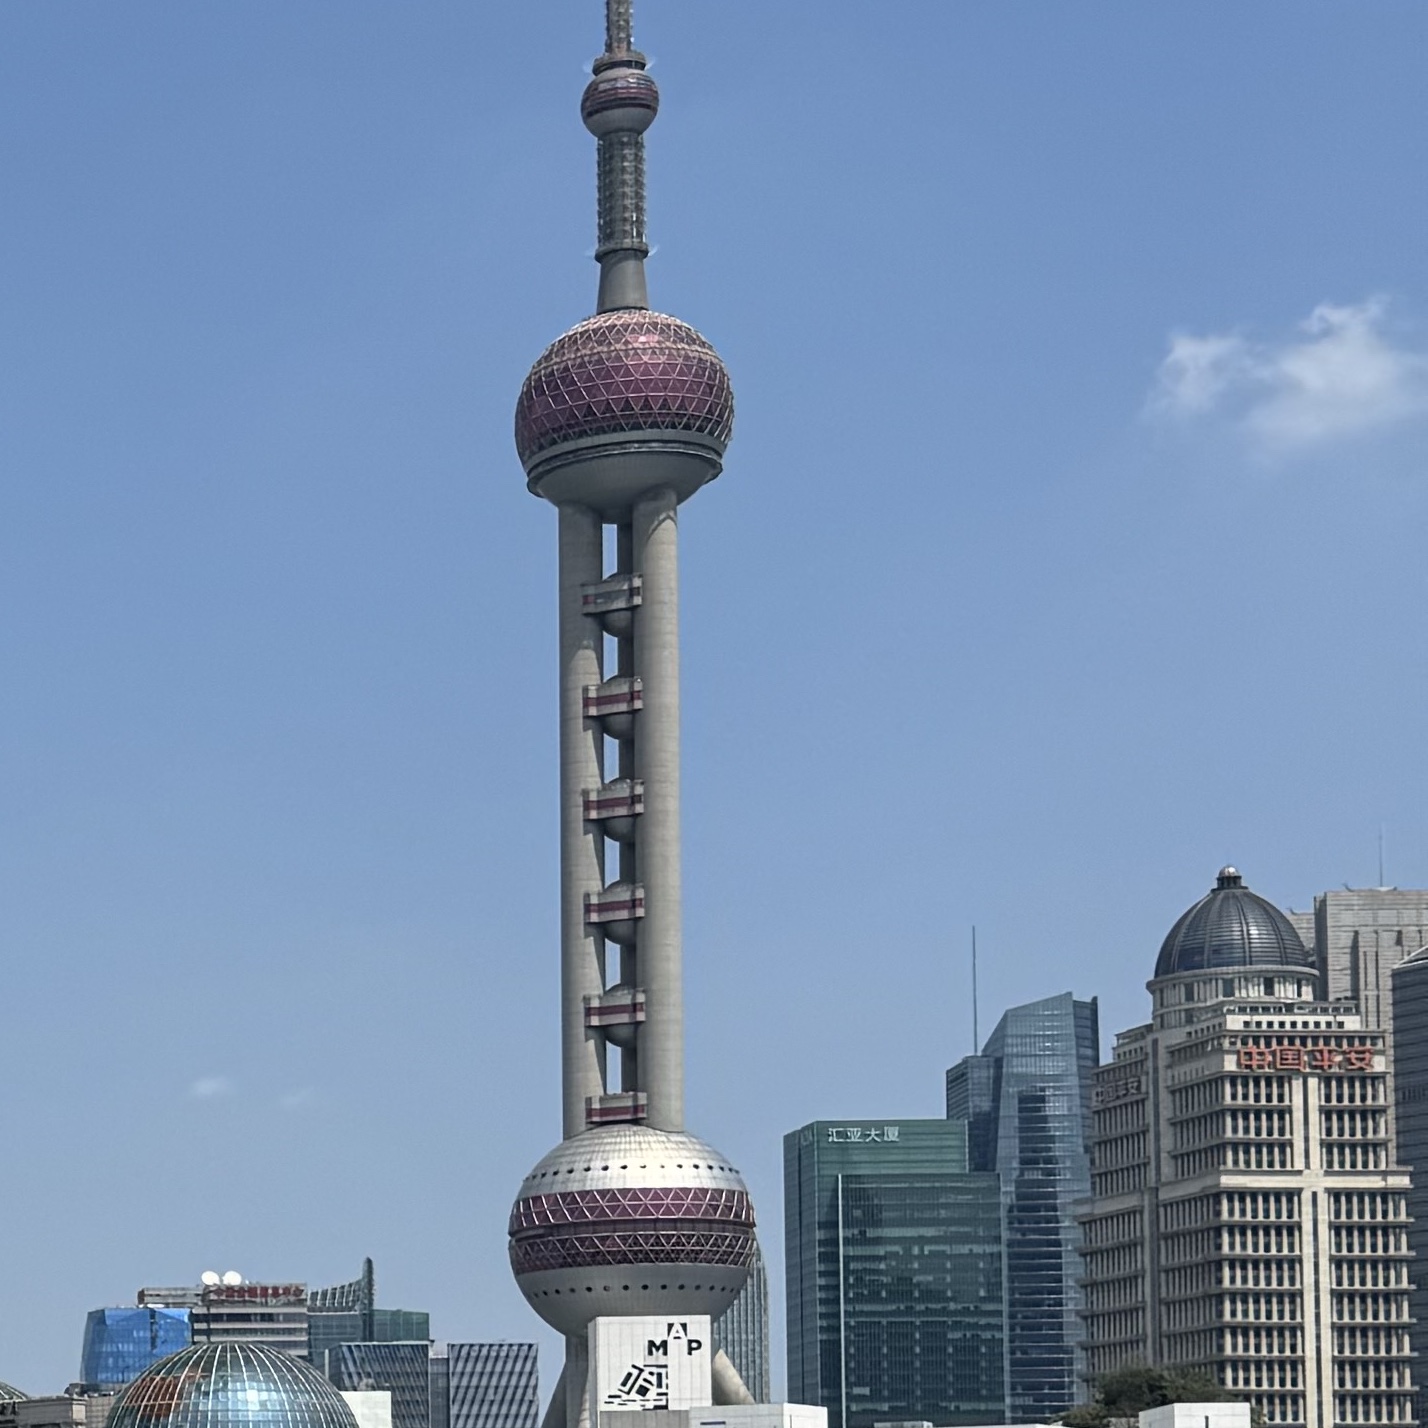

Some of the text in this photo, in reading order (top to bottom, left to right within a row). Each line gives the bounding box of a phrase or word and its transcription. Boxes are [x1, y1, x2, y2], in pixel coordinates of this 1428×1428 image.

[1240, 1045, 1375, 1072] 中国平安
[827, 1126, 900, 1143] 汇亚大厦
[647, 1322, 703, 1356] MAP
